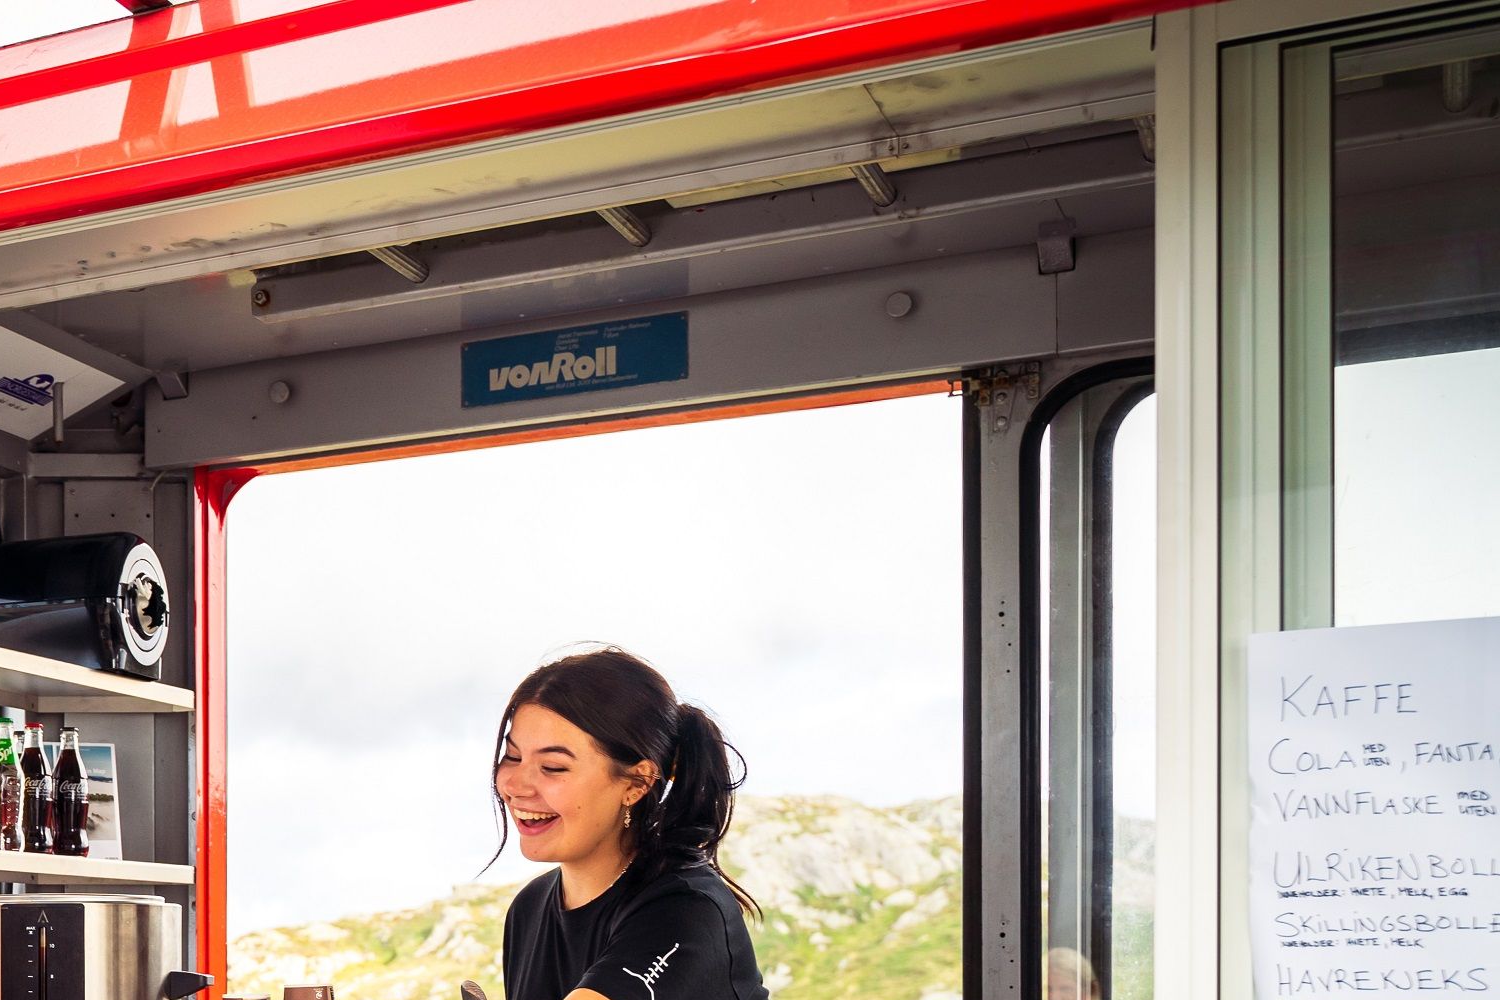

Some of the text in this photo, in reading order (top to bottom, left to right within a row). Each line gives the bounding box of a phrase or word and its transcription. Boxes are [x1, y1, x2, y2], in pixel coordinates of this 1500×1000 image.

[489, 345, 617, 391] vonRoll
[1280, 674, 1418, 722] KAFFE
[1457, 789, 1490, 801] MED
